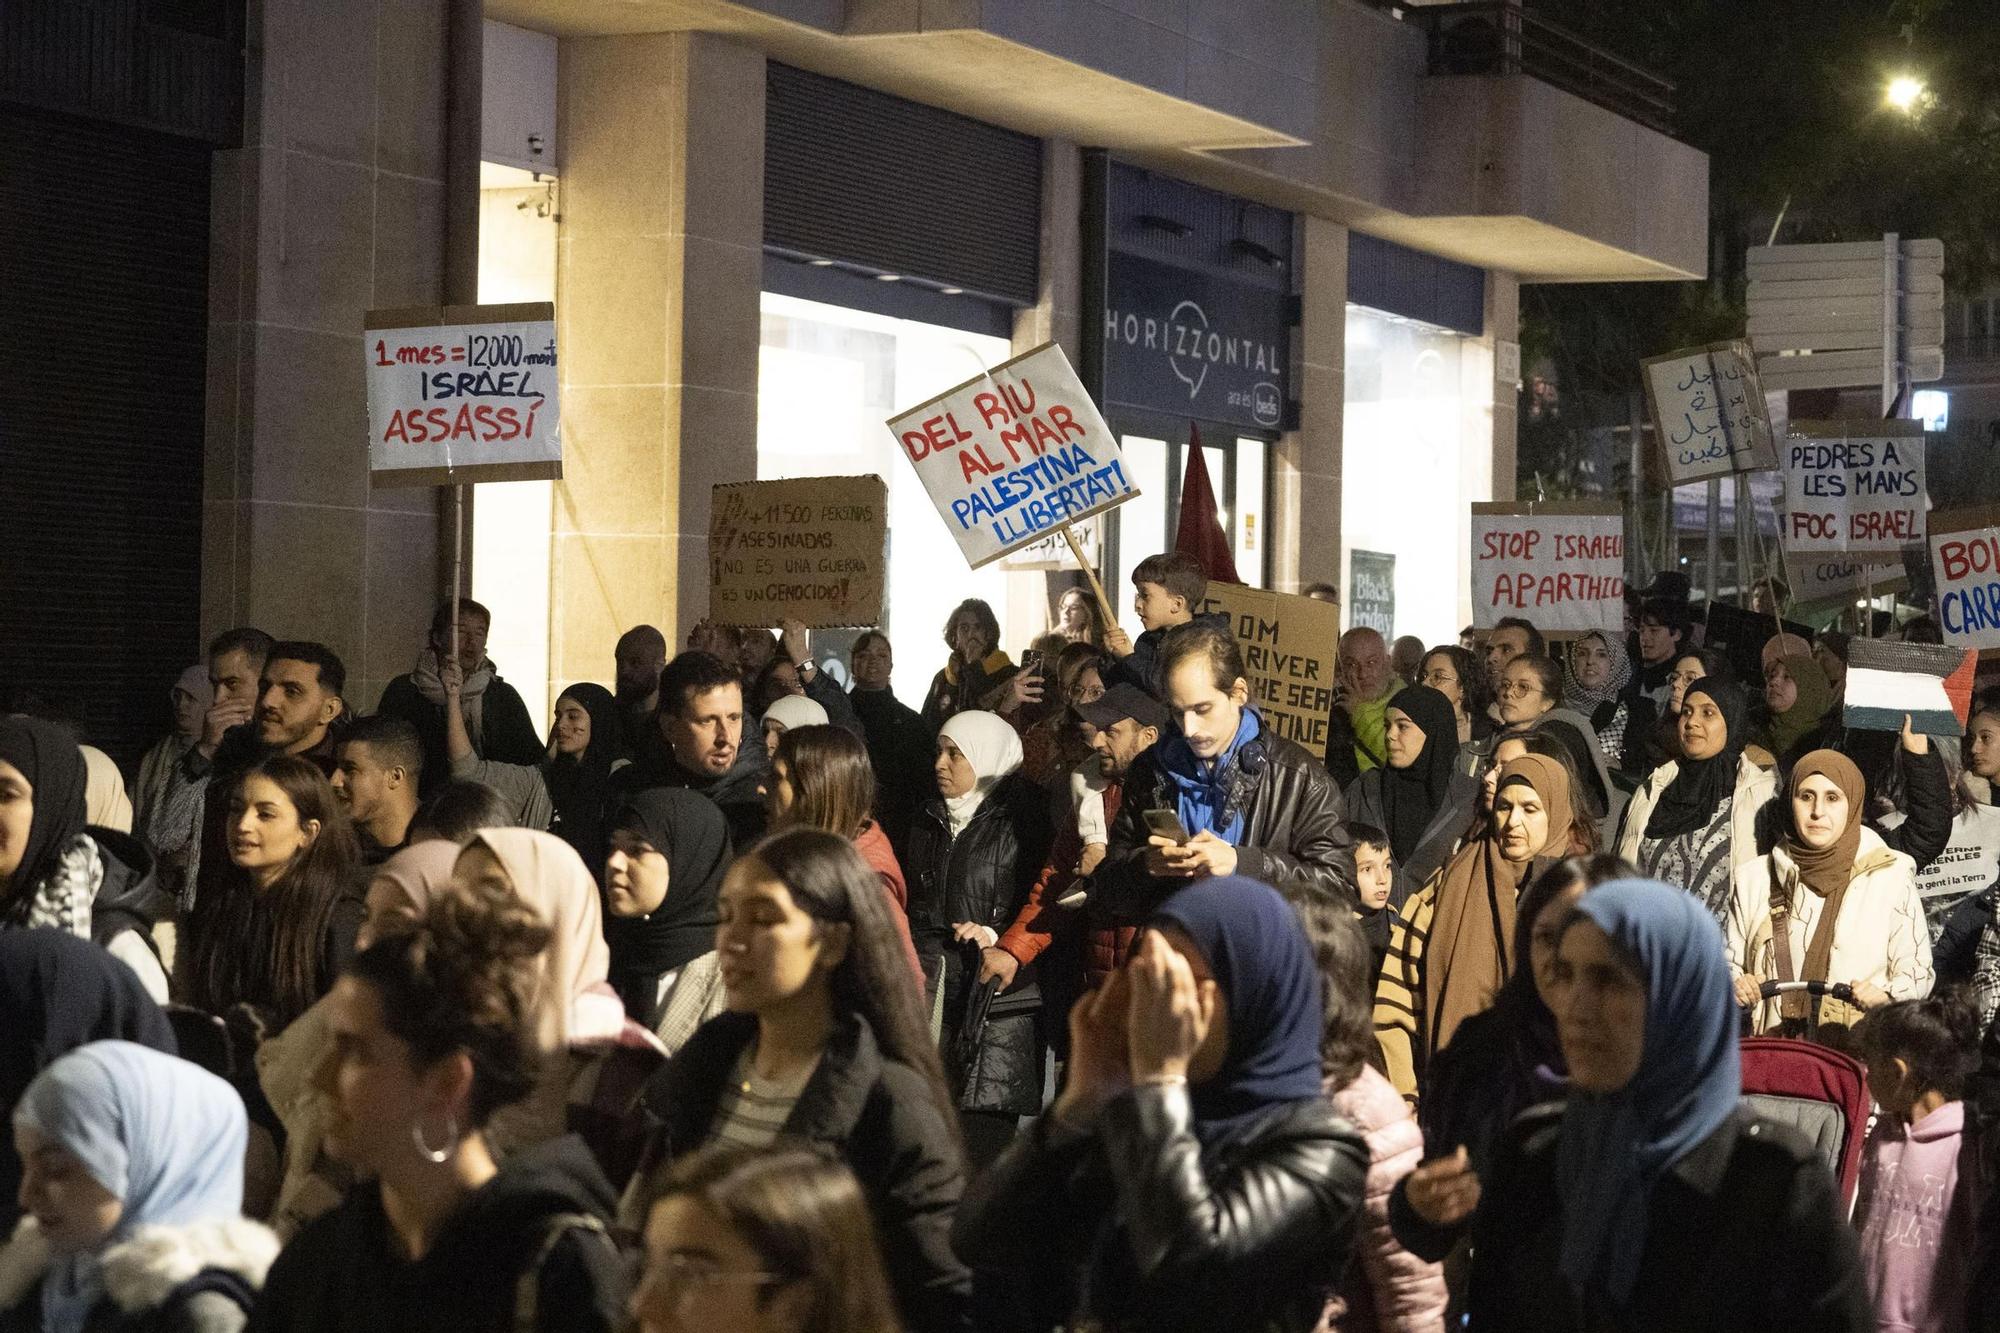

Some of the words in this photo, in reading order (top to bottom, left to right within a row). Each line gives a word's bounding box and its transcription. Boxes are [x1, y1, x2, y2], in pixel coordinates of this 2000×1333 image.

[376, 339, 395, 367] 1
[397, 344, 446, 364] mes
[1104, 309, 1280, 375] HORIZZONTAL
[421, 371, 545, 400] ISRAEL
[383, 398, 545, 443] ASSASSÍ
[902, 412, 972, 462] DEL
[973, 378, 1036, 430] RIU
[958, 443, 1005, 484] AL
[1000, 405, 1086, 463] MAR
[1791, 443, 1874, 470] PEDRES
[1882, 441, 1900, 465] A
[951, 443, 1097, 529] PALESTINA
[1803, 474, 1846, 496] LES
[1855, 470, 1918, 496] MANS
[992, 459, 1132, 545] LLIBERTAT!
[1791, 512, 1837, 540] FOC
[1850, 509, 1921, 541] ISRAEL
[1480, 530, 1540, 560] STOP
[756, 559, 774, 575] ES
[785, 559, 811, 574] UNA
[818, 559, 867, 574] GUERRA
[744, 588, 764, 602] UN
[1356, 573, 1390, 602] Black
[1353, 602, 1393, 642] Friday
[1247, 645, 1319, 681] RIVER
[1287, 683, 1331, 712] SEA
[1957, 852, 1981, 861] LES
[1925, 879, 1946, 890] gent
[1947, 876, 1951, 885] i
[1952, 876, 1961, 884] la
[1962, 874, 1986, 882] Terra
